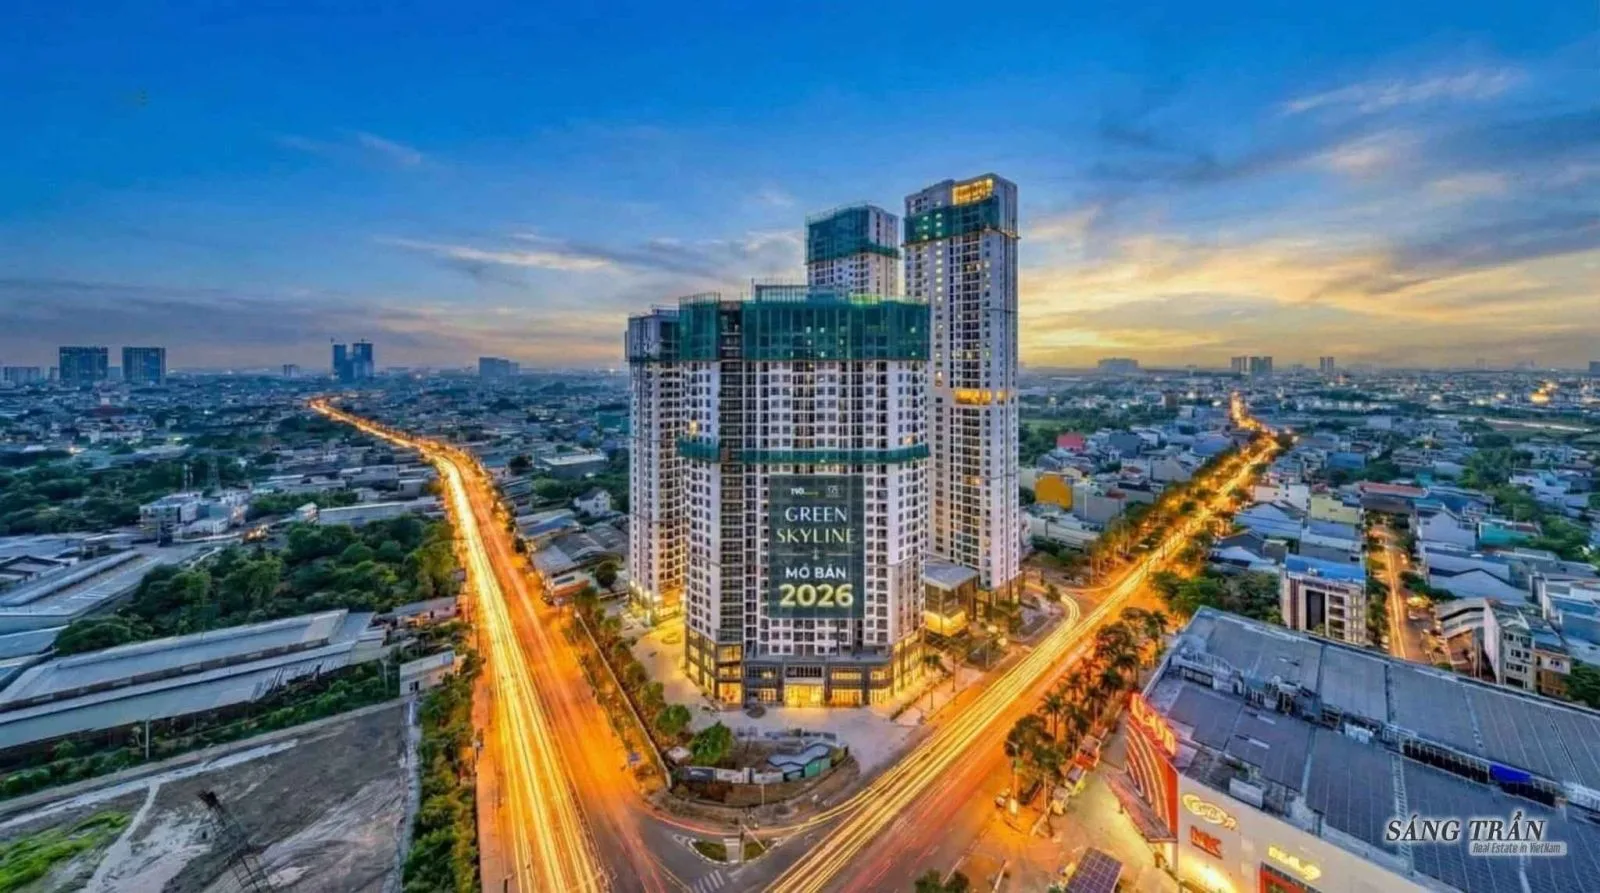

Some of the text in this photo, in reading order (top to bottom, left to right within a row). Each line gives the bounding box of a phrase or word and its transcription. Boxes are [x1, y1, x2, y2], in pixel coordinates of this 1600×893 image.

[785, 507, 847, 522] GREEN
[776, 528, 855, 543] SKYLINE
[779, 584, 854, 607] 2026
